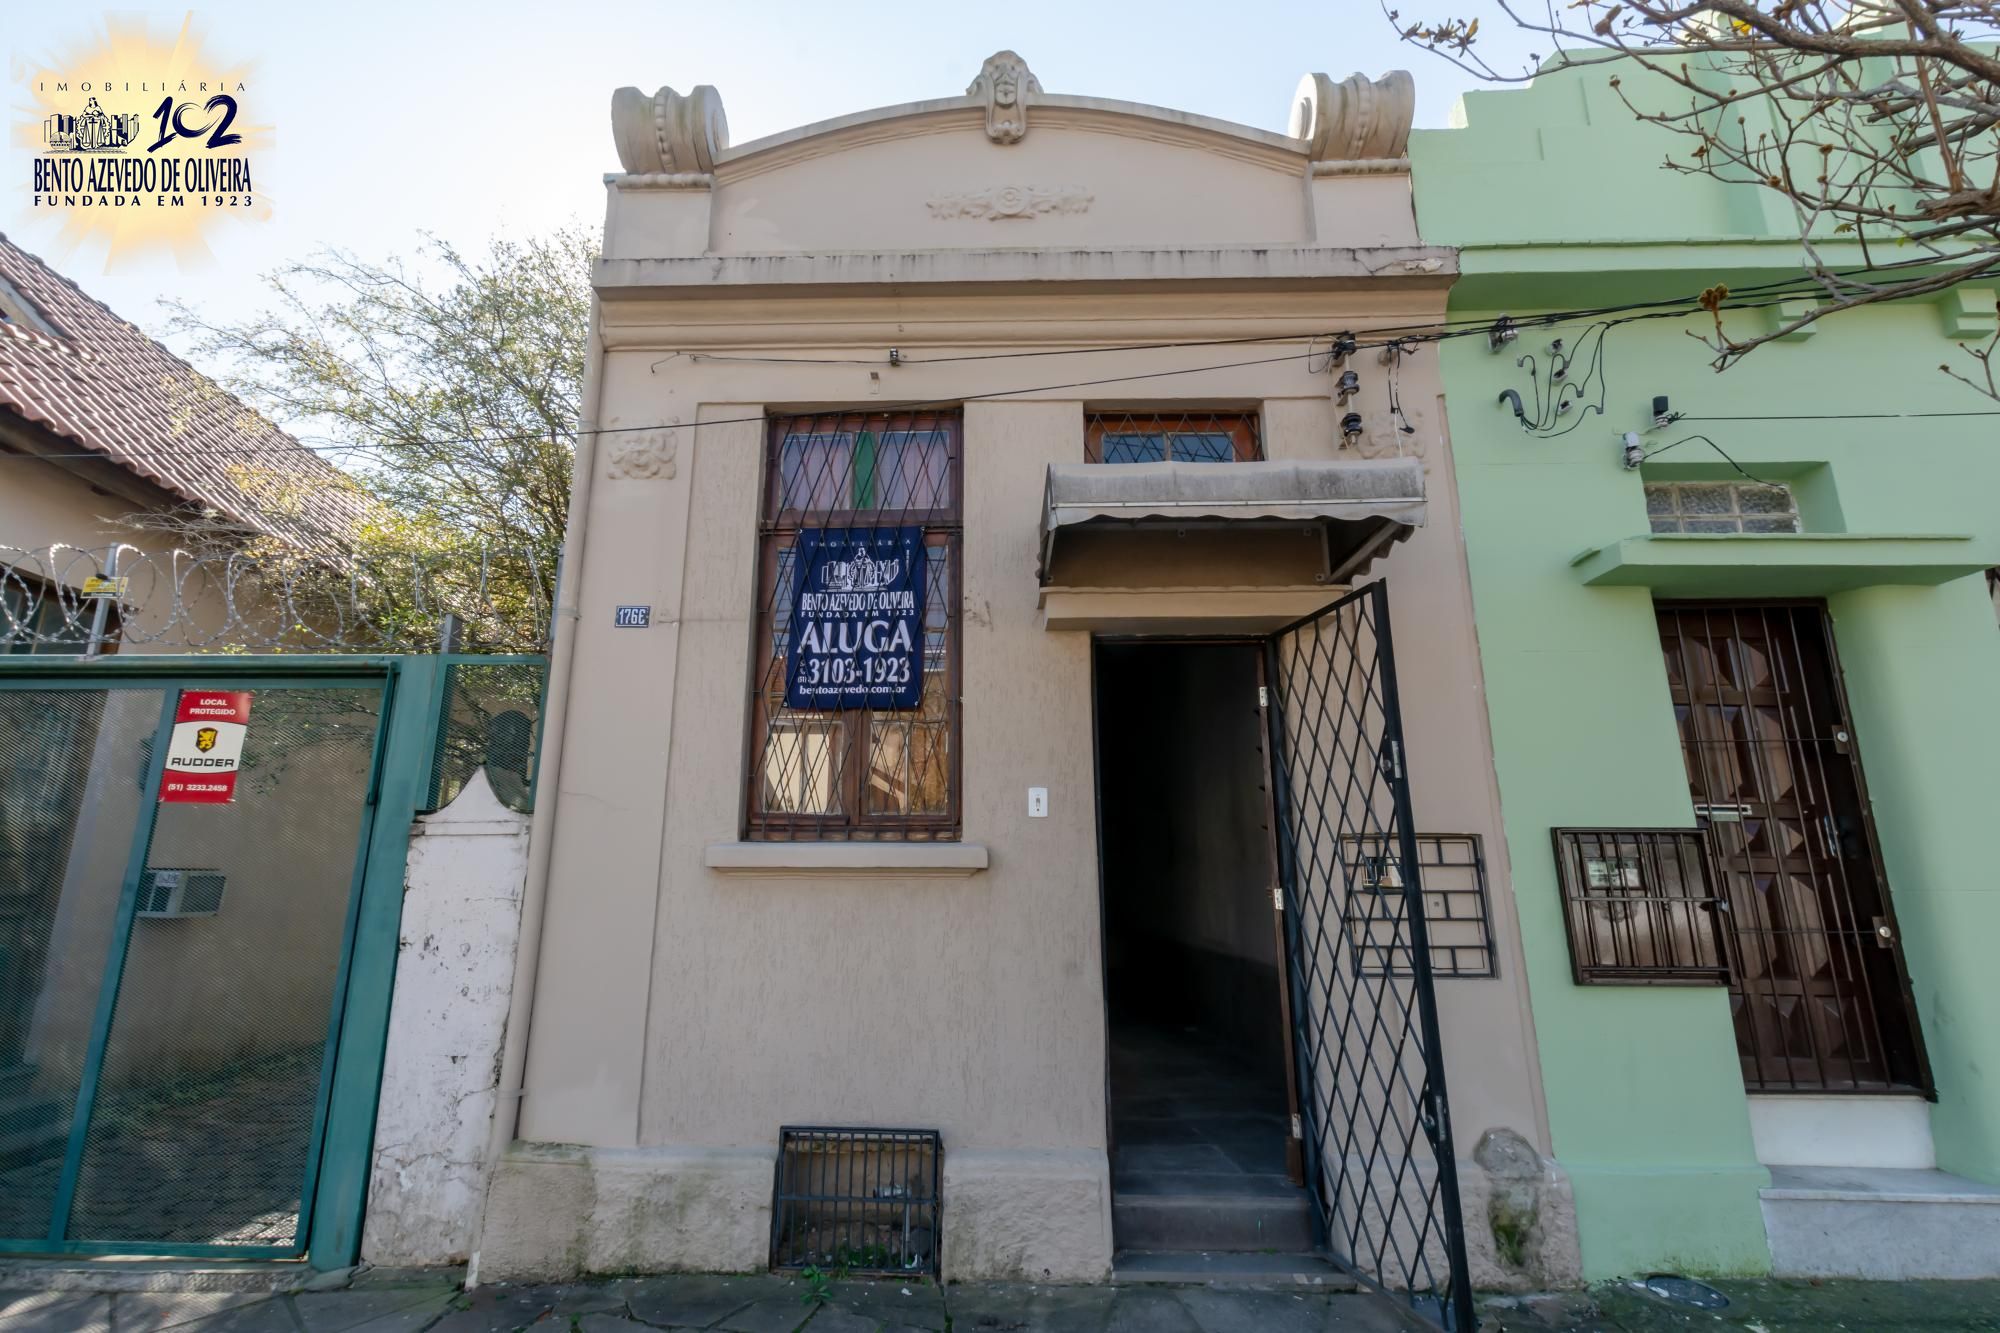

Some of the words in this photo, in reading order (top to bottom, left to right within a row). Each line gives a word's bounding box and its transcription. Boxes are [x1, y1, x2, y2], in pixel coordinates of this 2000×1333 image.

[796, 620, 914, 654] ALUGA
[808, 656, 910, 684] 3103-1923
[171, 757, 235, 767] RUDDER
[167, 783, 184, 791] (51)
